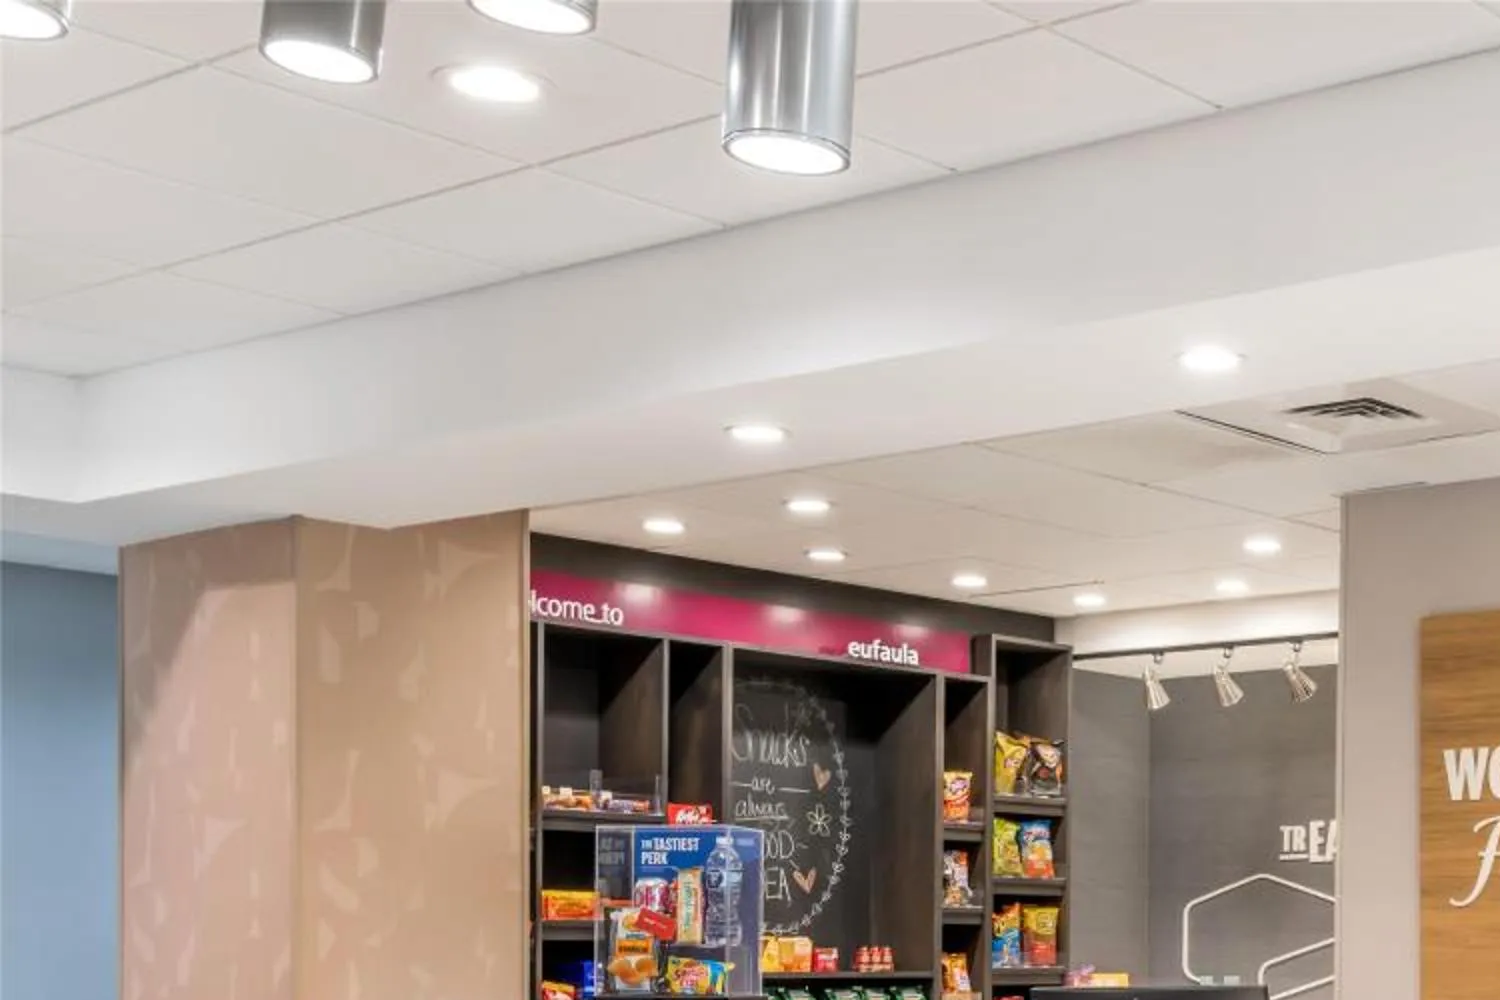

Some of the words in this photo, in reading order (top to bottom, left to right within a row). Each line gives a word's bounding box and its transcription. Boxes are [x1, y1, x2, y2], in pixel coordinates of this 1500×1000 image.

[528, 589, 602, 623] lcome
[601, 602, 624, 626] to
[847, 637, 919, 666] eufaula
[751, 776, 776, 795] are
[652, 836, 701, 852] TASTIEST
[641, 851, 668, 866] PERK
